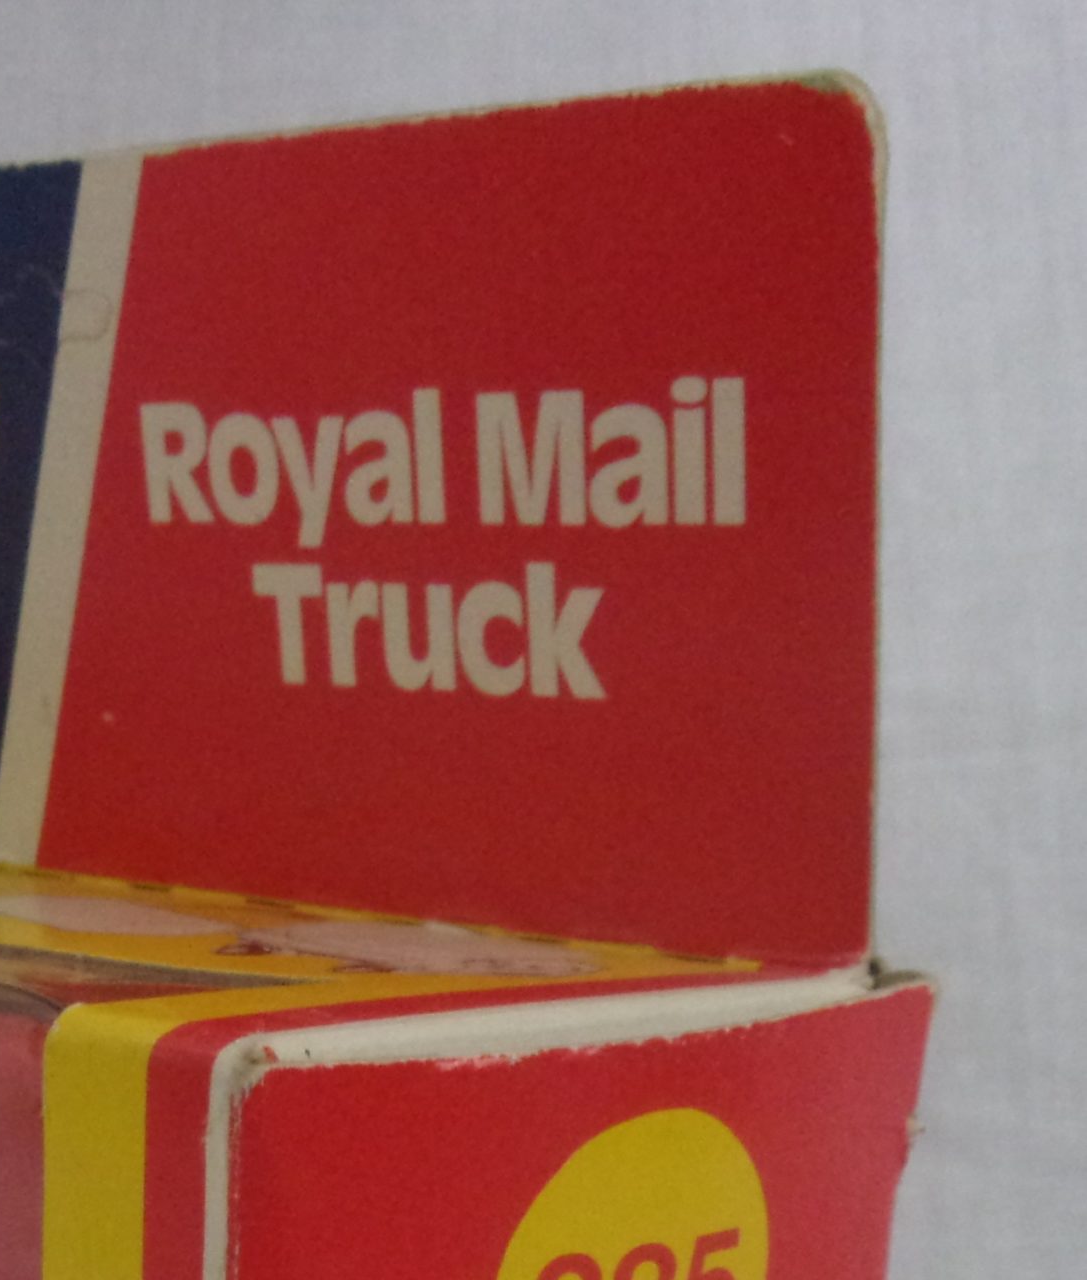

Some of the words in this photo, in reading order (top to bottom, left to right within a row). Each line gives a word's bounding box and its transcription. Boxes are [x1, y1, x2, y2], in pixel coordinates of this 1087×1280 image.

[139, 387, 447, 549] Royal
[475, 375, 746, 528] Mail
[251, 560, 607, 700] Truck
